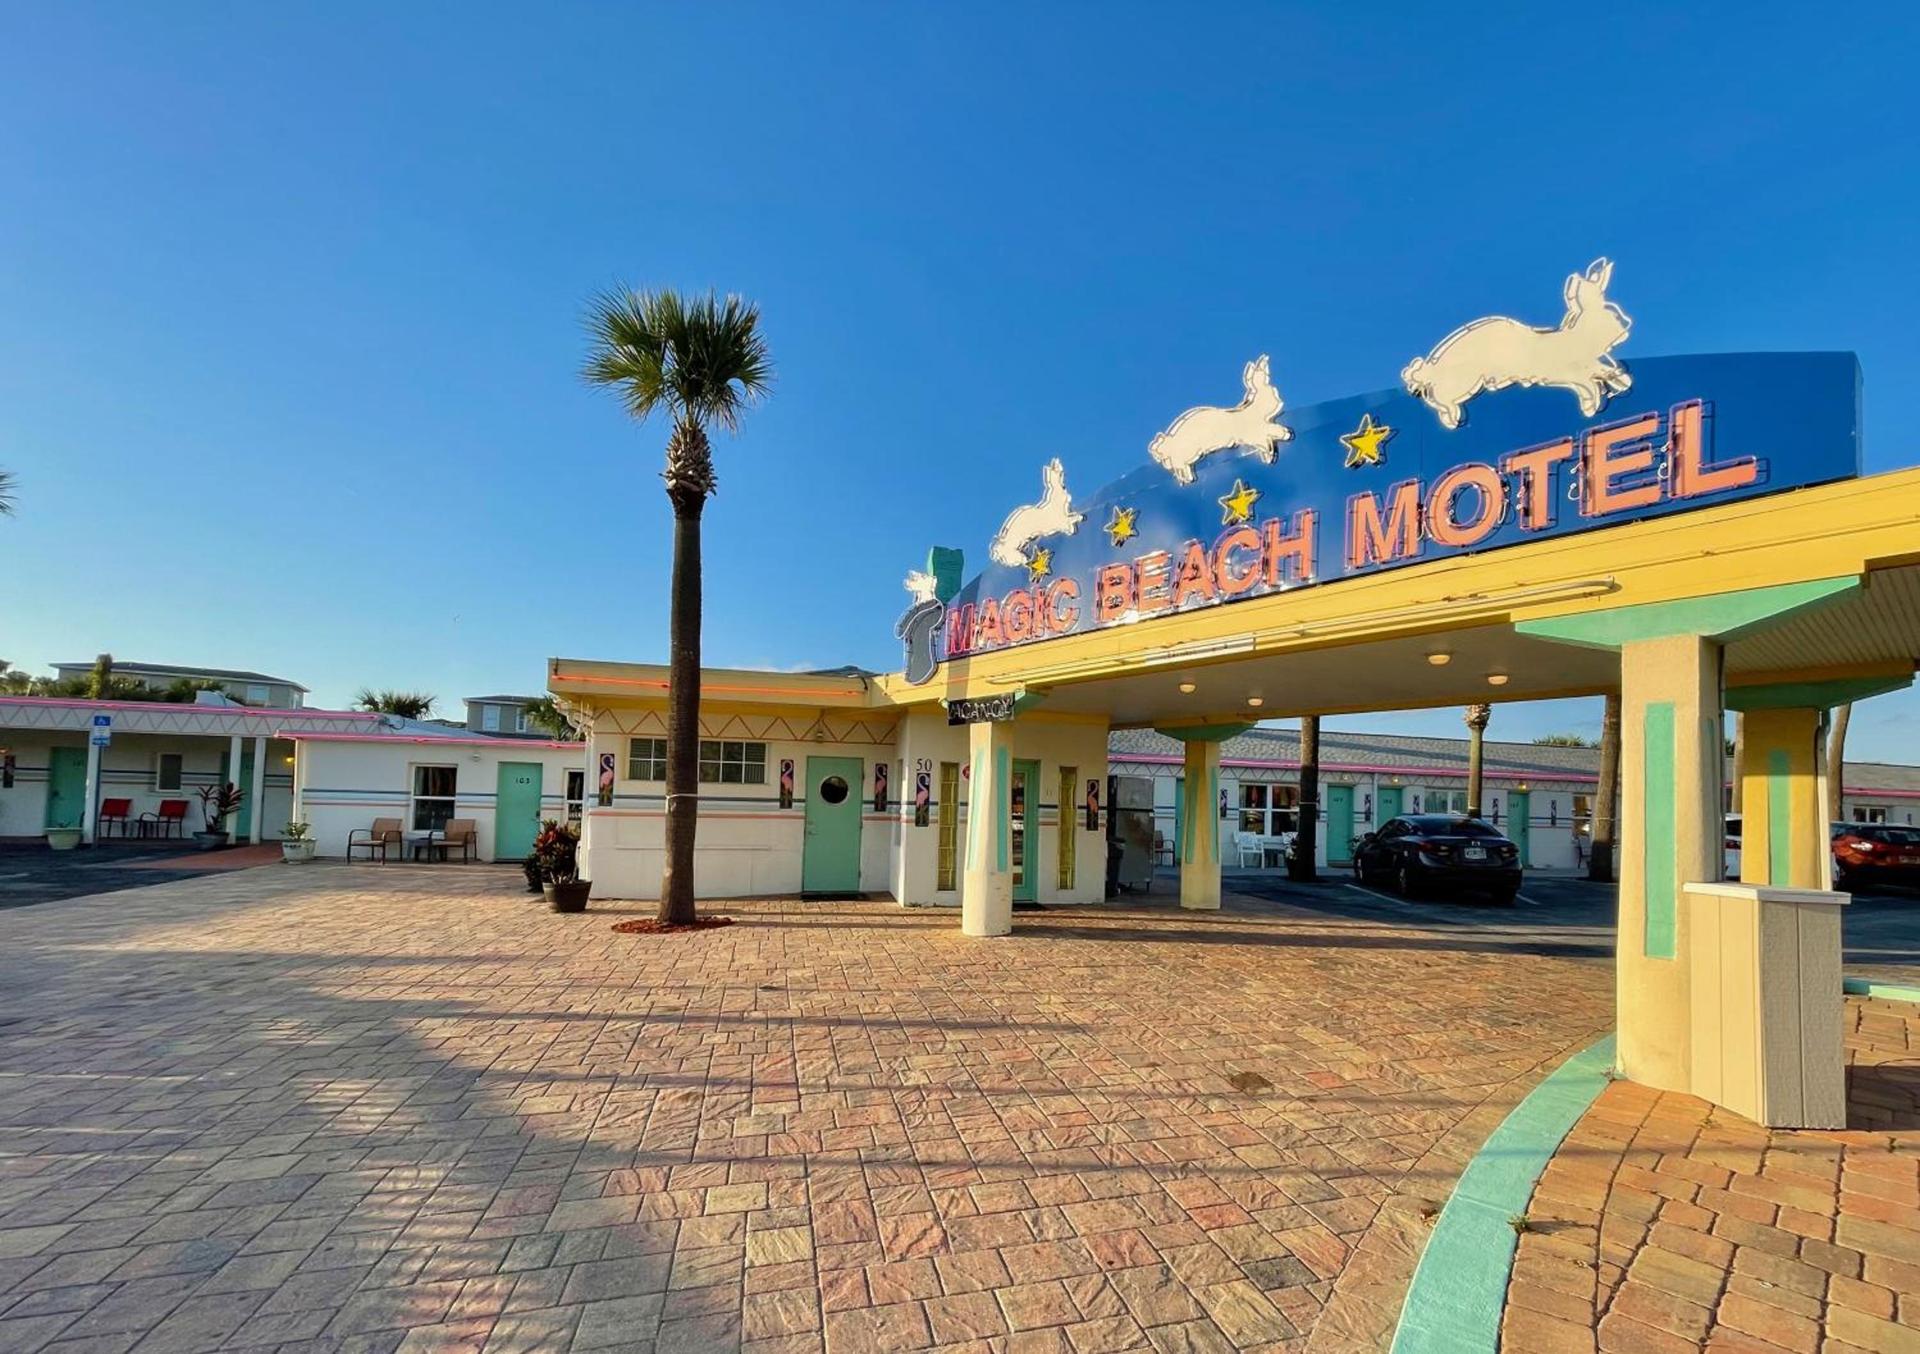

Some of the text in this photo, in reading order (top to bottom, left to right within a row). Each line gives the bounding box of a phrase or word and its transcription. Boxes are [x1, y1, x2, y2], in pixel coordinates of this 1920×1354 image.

[945, 398, 1757, 655] MAGIC BEACH MOTEL
[915, 758, 933, 772] 50
